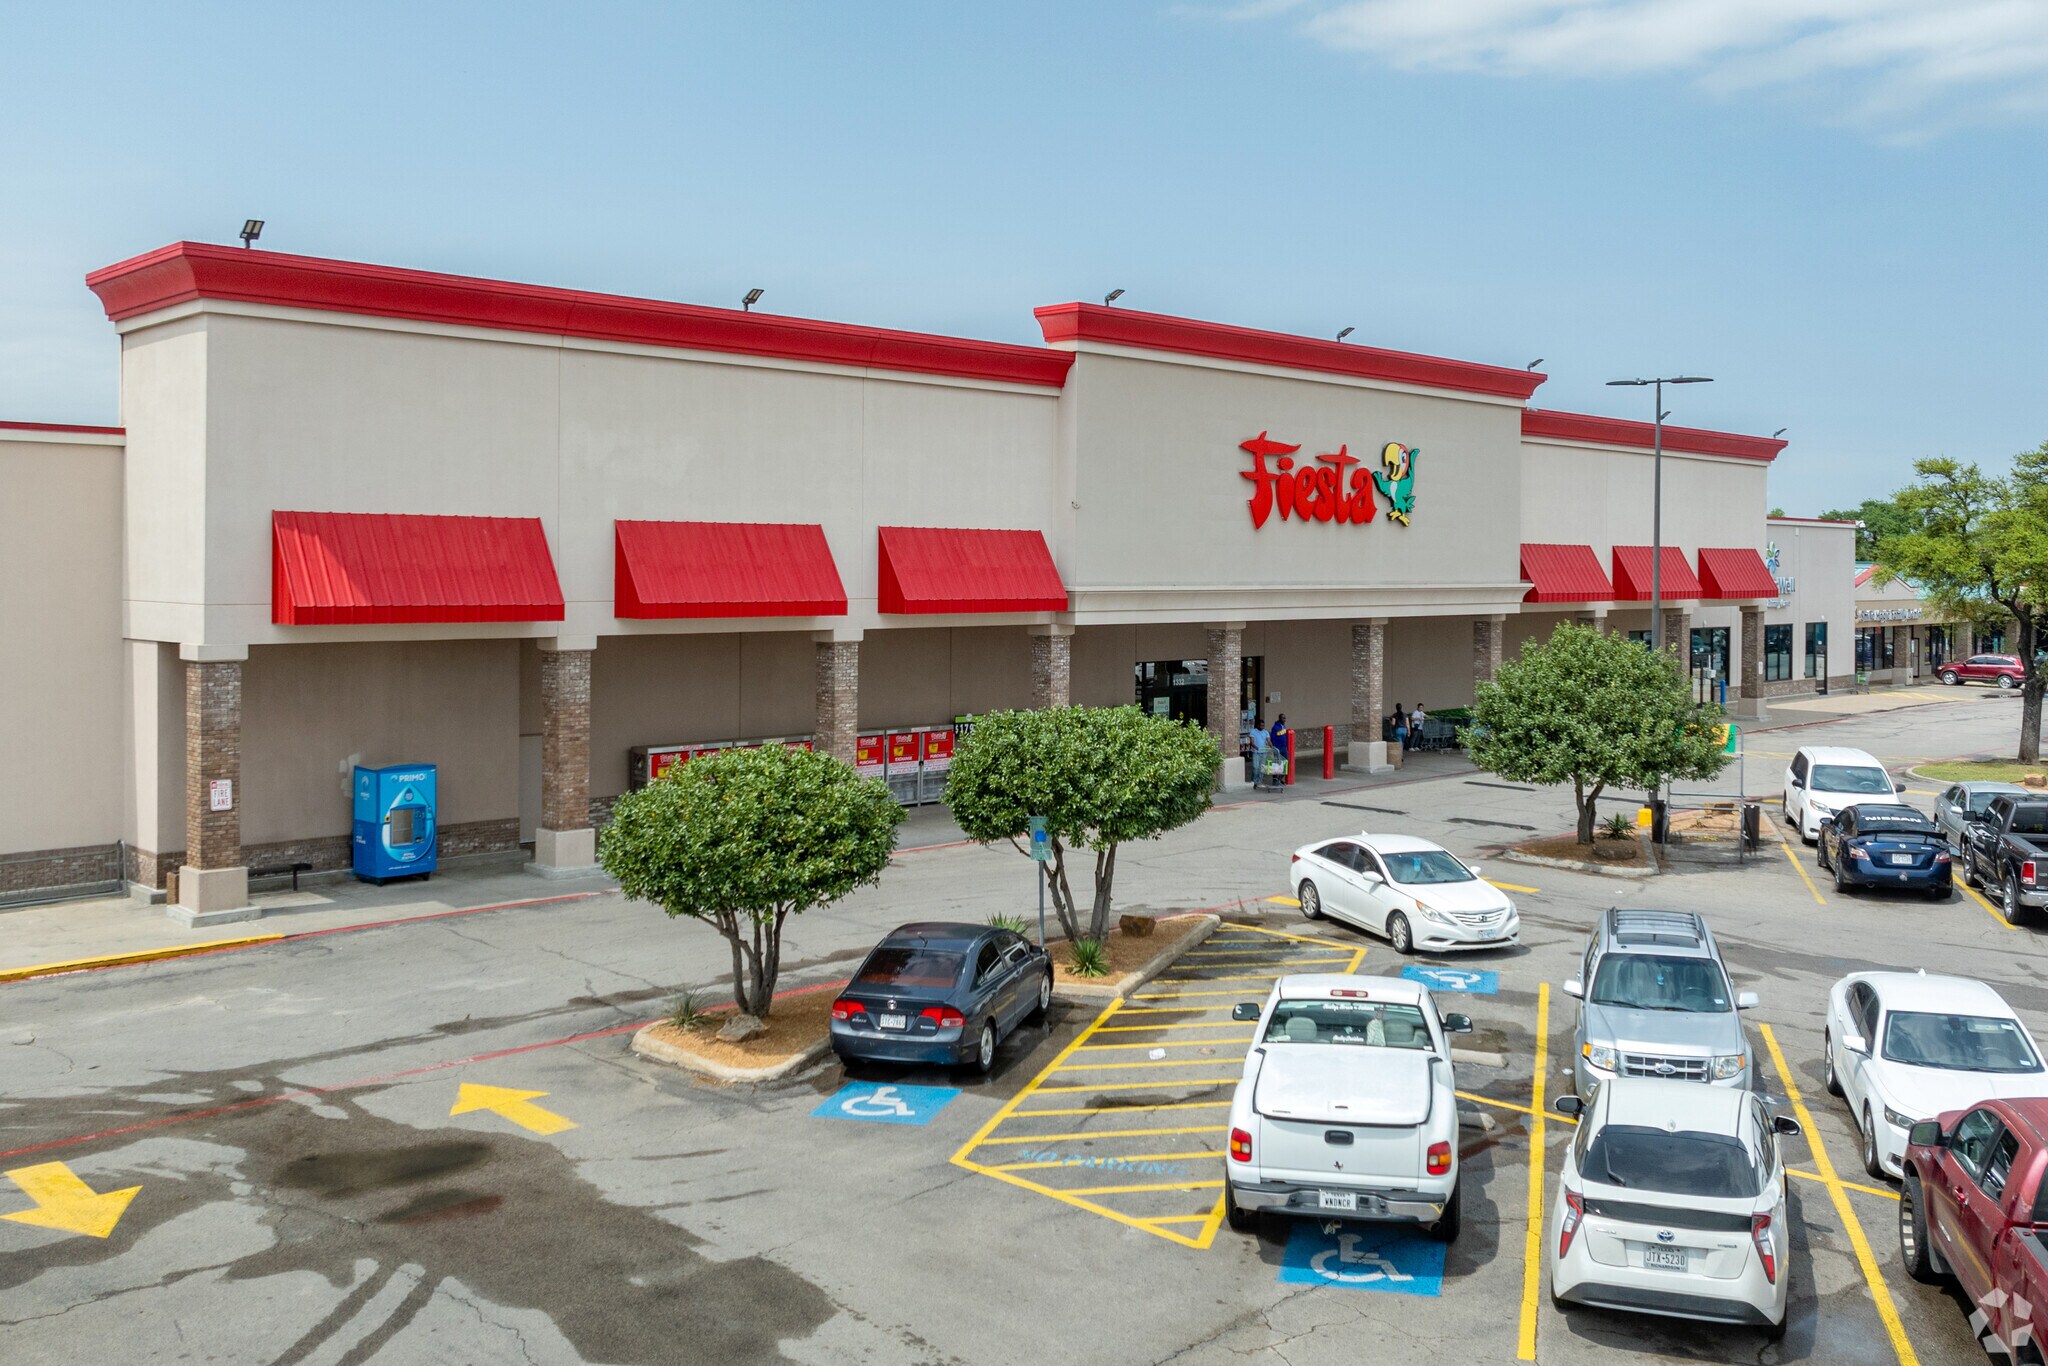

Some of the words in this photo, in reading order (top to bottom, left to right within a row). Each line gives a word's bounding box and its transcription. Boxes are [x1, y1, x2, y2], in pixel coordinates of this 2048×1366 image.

[1238, 430, 1378, 529] Fiesta
[399, 773, 426, 782] PRIMO
[213, 797, 229, 807] LANE
[1022, 1149, 1058, 1163] NO
[1061, 1153, 1190, 1177] PARKING
